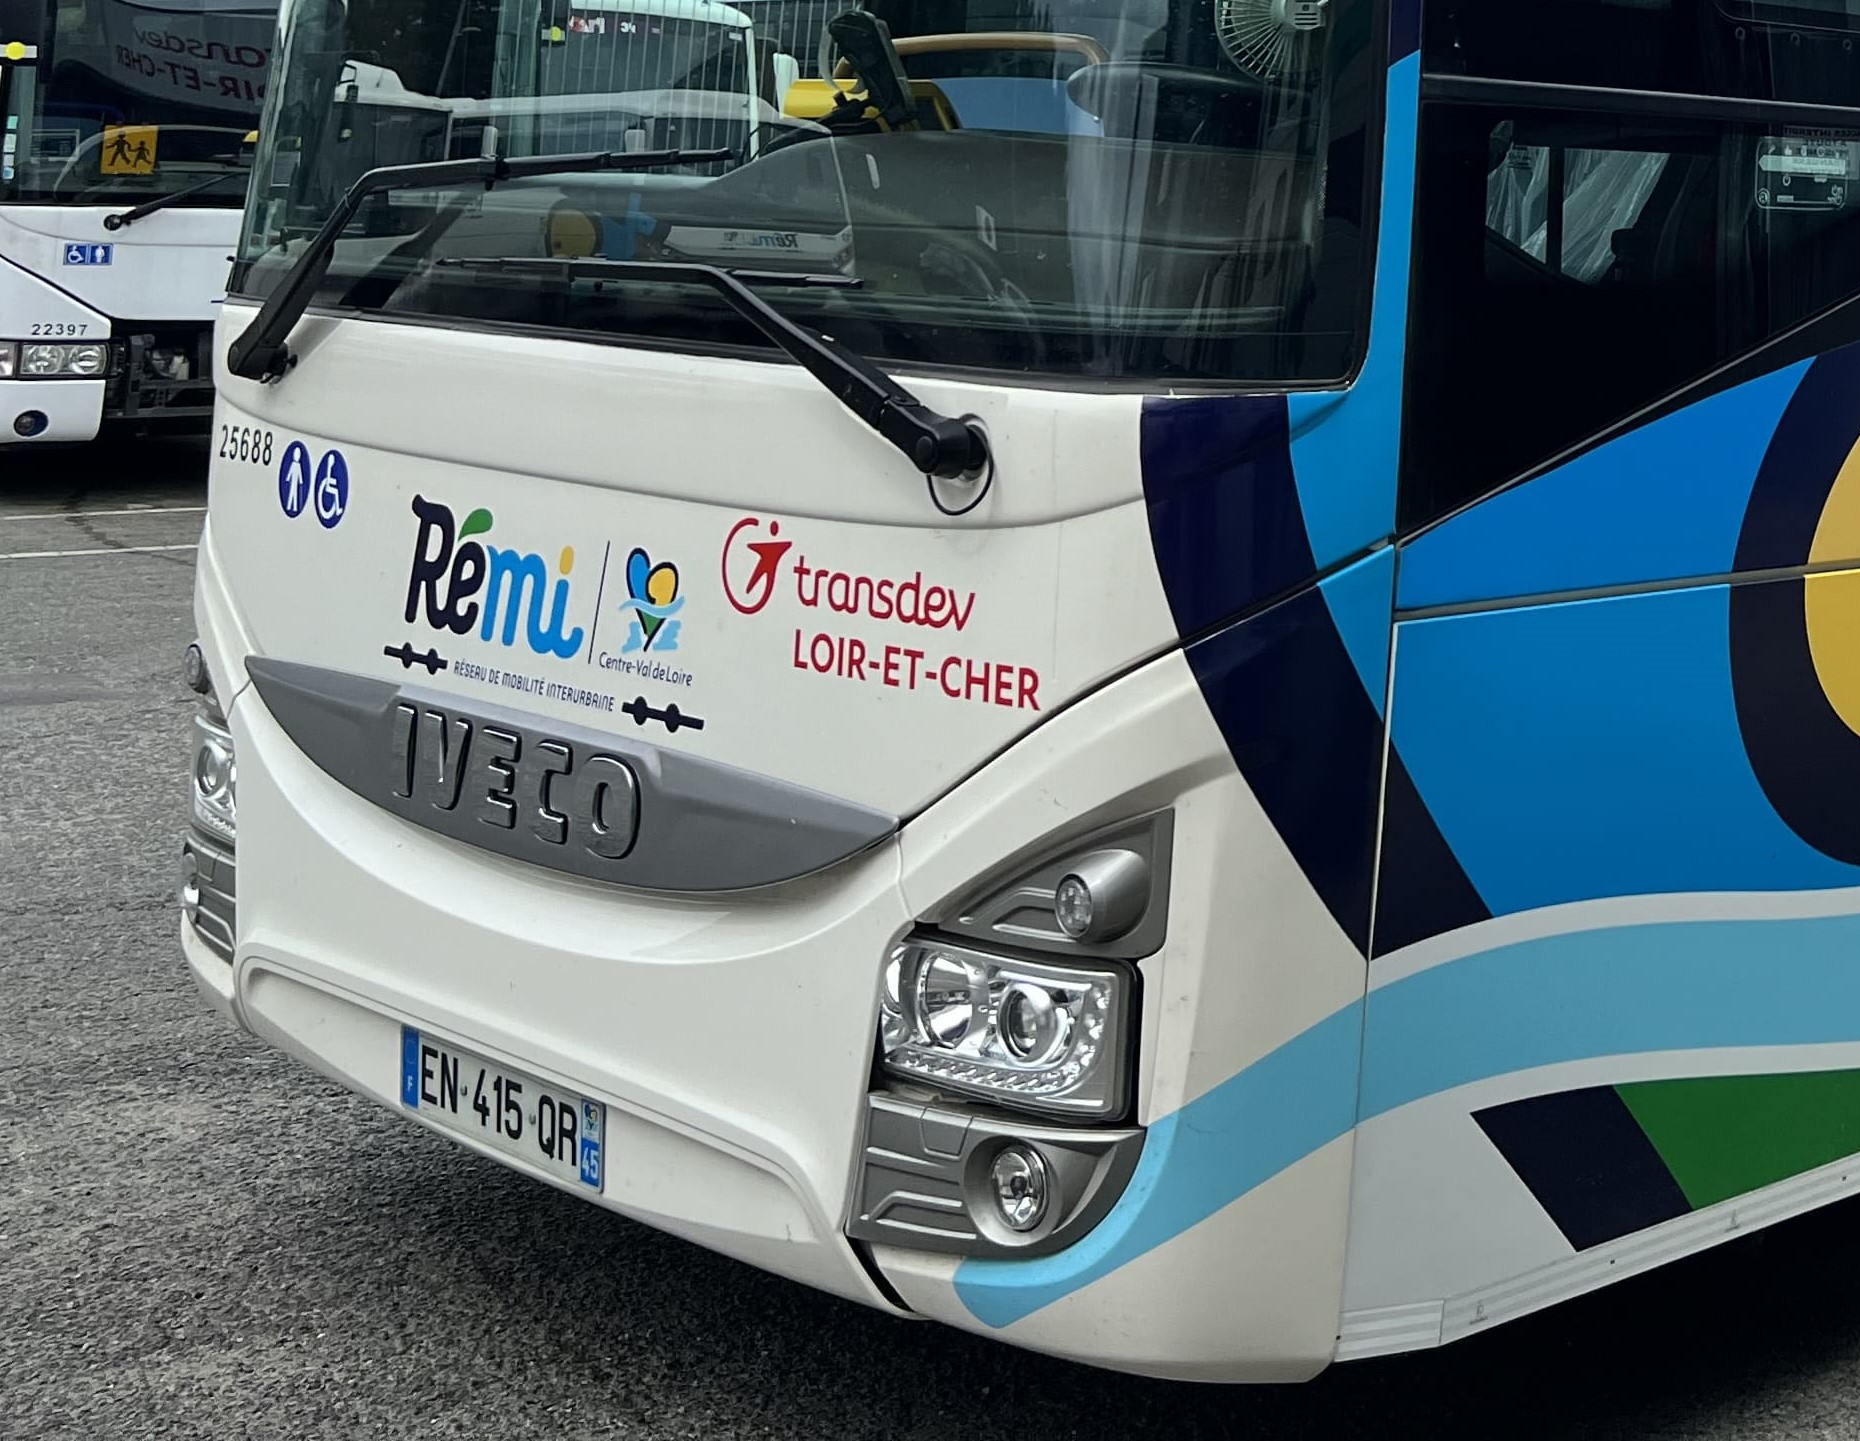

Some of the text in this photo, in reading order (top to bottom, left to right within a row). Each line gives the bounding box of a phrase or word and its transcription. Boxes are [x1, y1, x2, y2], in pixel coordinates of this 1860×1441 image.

[31, 323, 88, 336] 22397
[220, 424, 273, 466] 25688
[405, 494, 584, 658] Rémi
[794, 555, 976, 631] transdev
[453, 658, 615, 712] RÉSEAU DE MOBILITÉ INTERURBAINE
[599, 652, 651, 677] Centre-Val
[666, 665, 693, 687] Loire
[793, 629, 1041, 711] LOIR-ET-CHER
[391, 702, 642, 860] IVECO
[406, 1074, 414, 1093] F
[582, 1146, 600, 1179] 45
